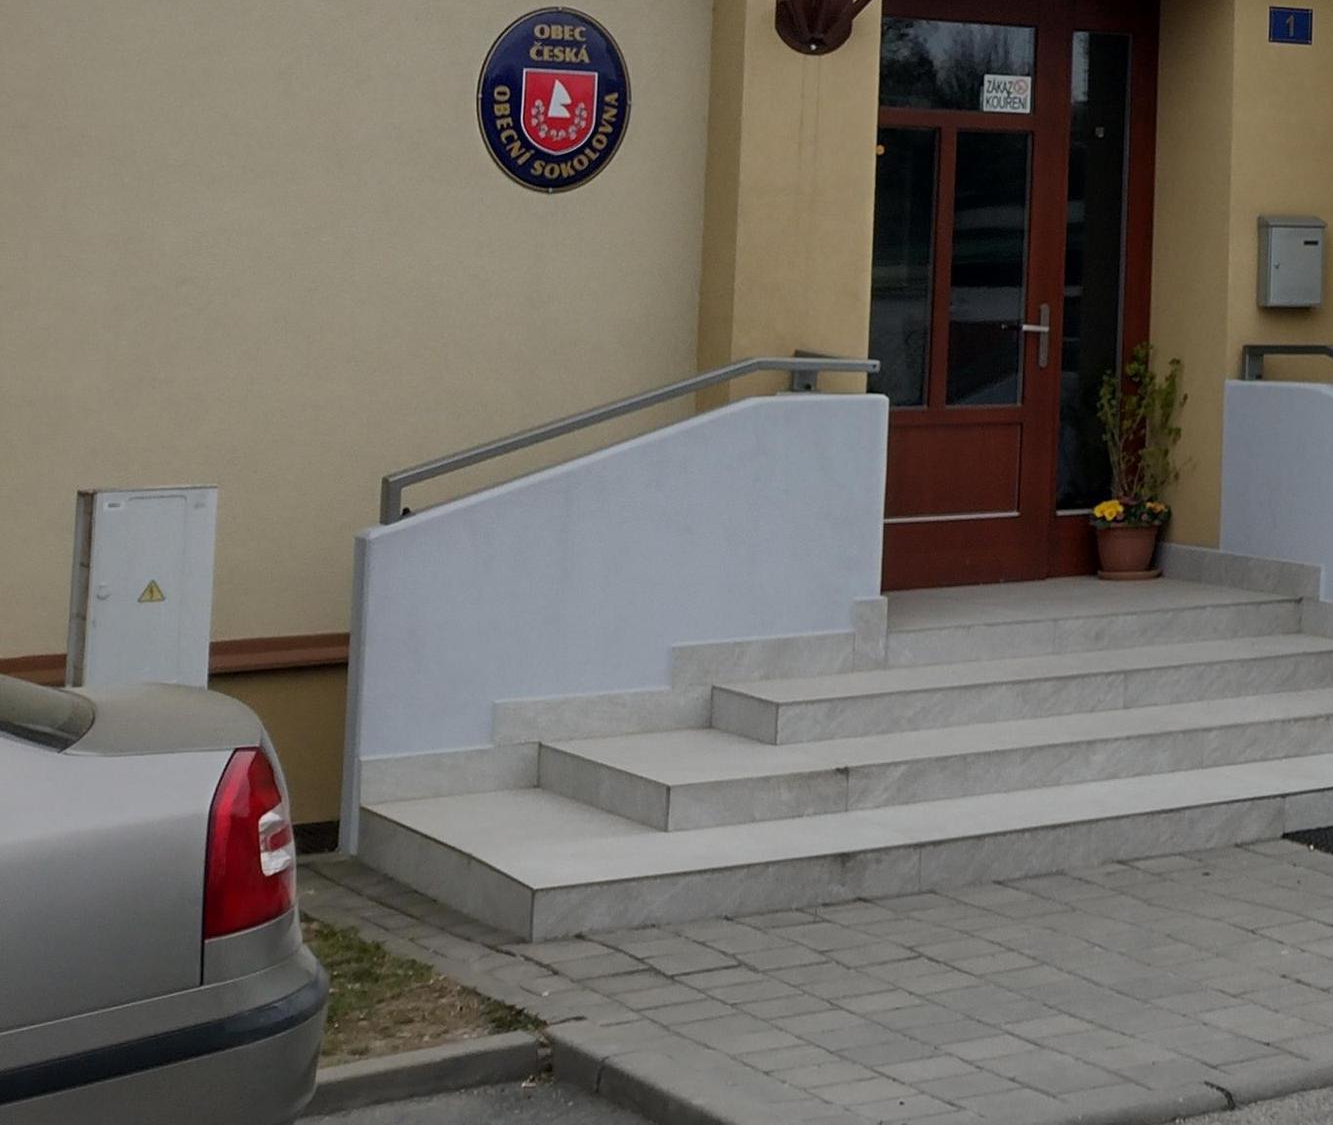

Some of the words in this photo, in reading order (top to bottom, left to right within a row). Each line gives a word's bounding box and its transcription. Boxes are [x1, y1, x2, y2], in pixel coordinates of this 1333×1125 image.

[534, 24, 587, 41] OBEC
[1286, 15, 1295, 37] 1
[529, 42, 591, 63] ČESKÁ
[986, 78, 1014, 94] ZÁKAZ
[986, 94, 1029, 110] KOUŘENÍ
[494, 85, 535, 165] OBECNÍ
[531, 92, 618, 179] SOKOLOVNA
